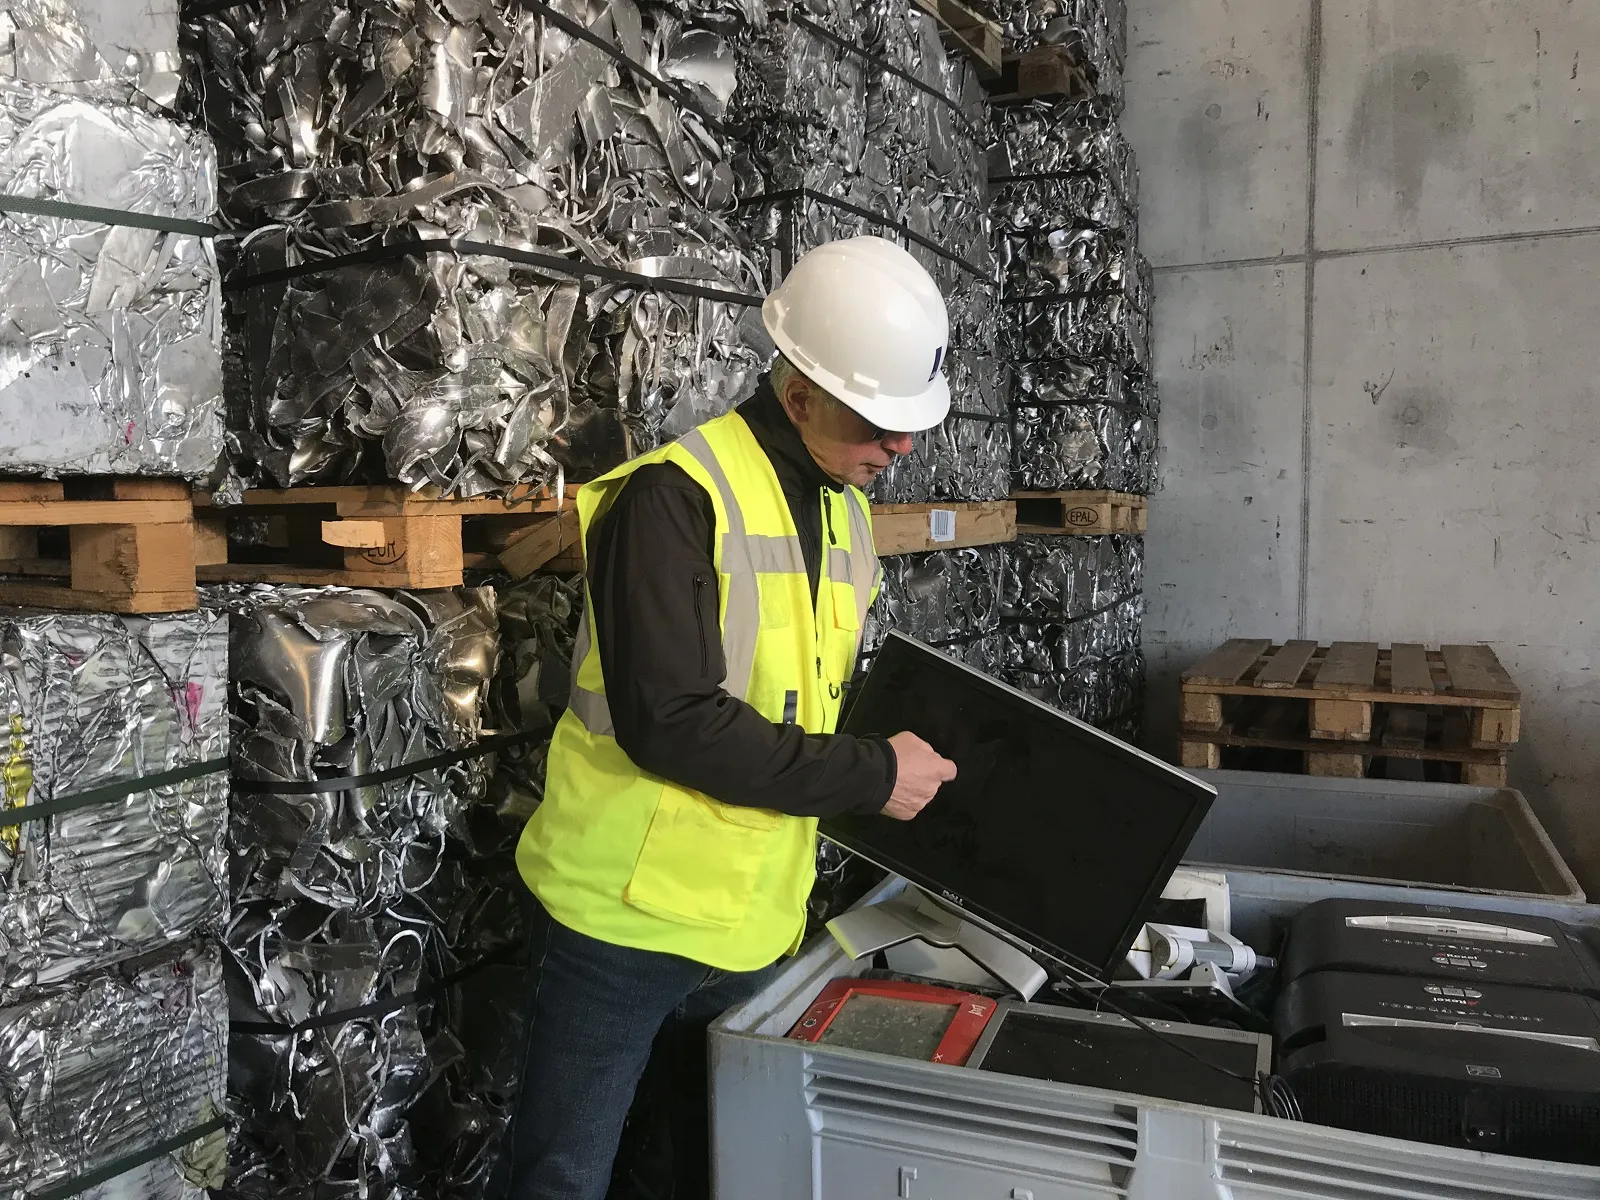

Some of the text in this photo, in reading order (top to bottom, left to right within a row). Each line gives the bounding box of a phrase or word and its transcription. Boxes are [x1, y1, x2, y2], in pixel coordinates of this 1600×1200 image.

[1070, 511, 1093, 522] EPAL
[942, 889, 963, 906] DELL
[1433, 997, 1467, 1005] Rexel
